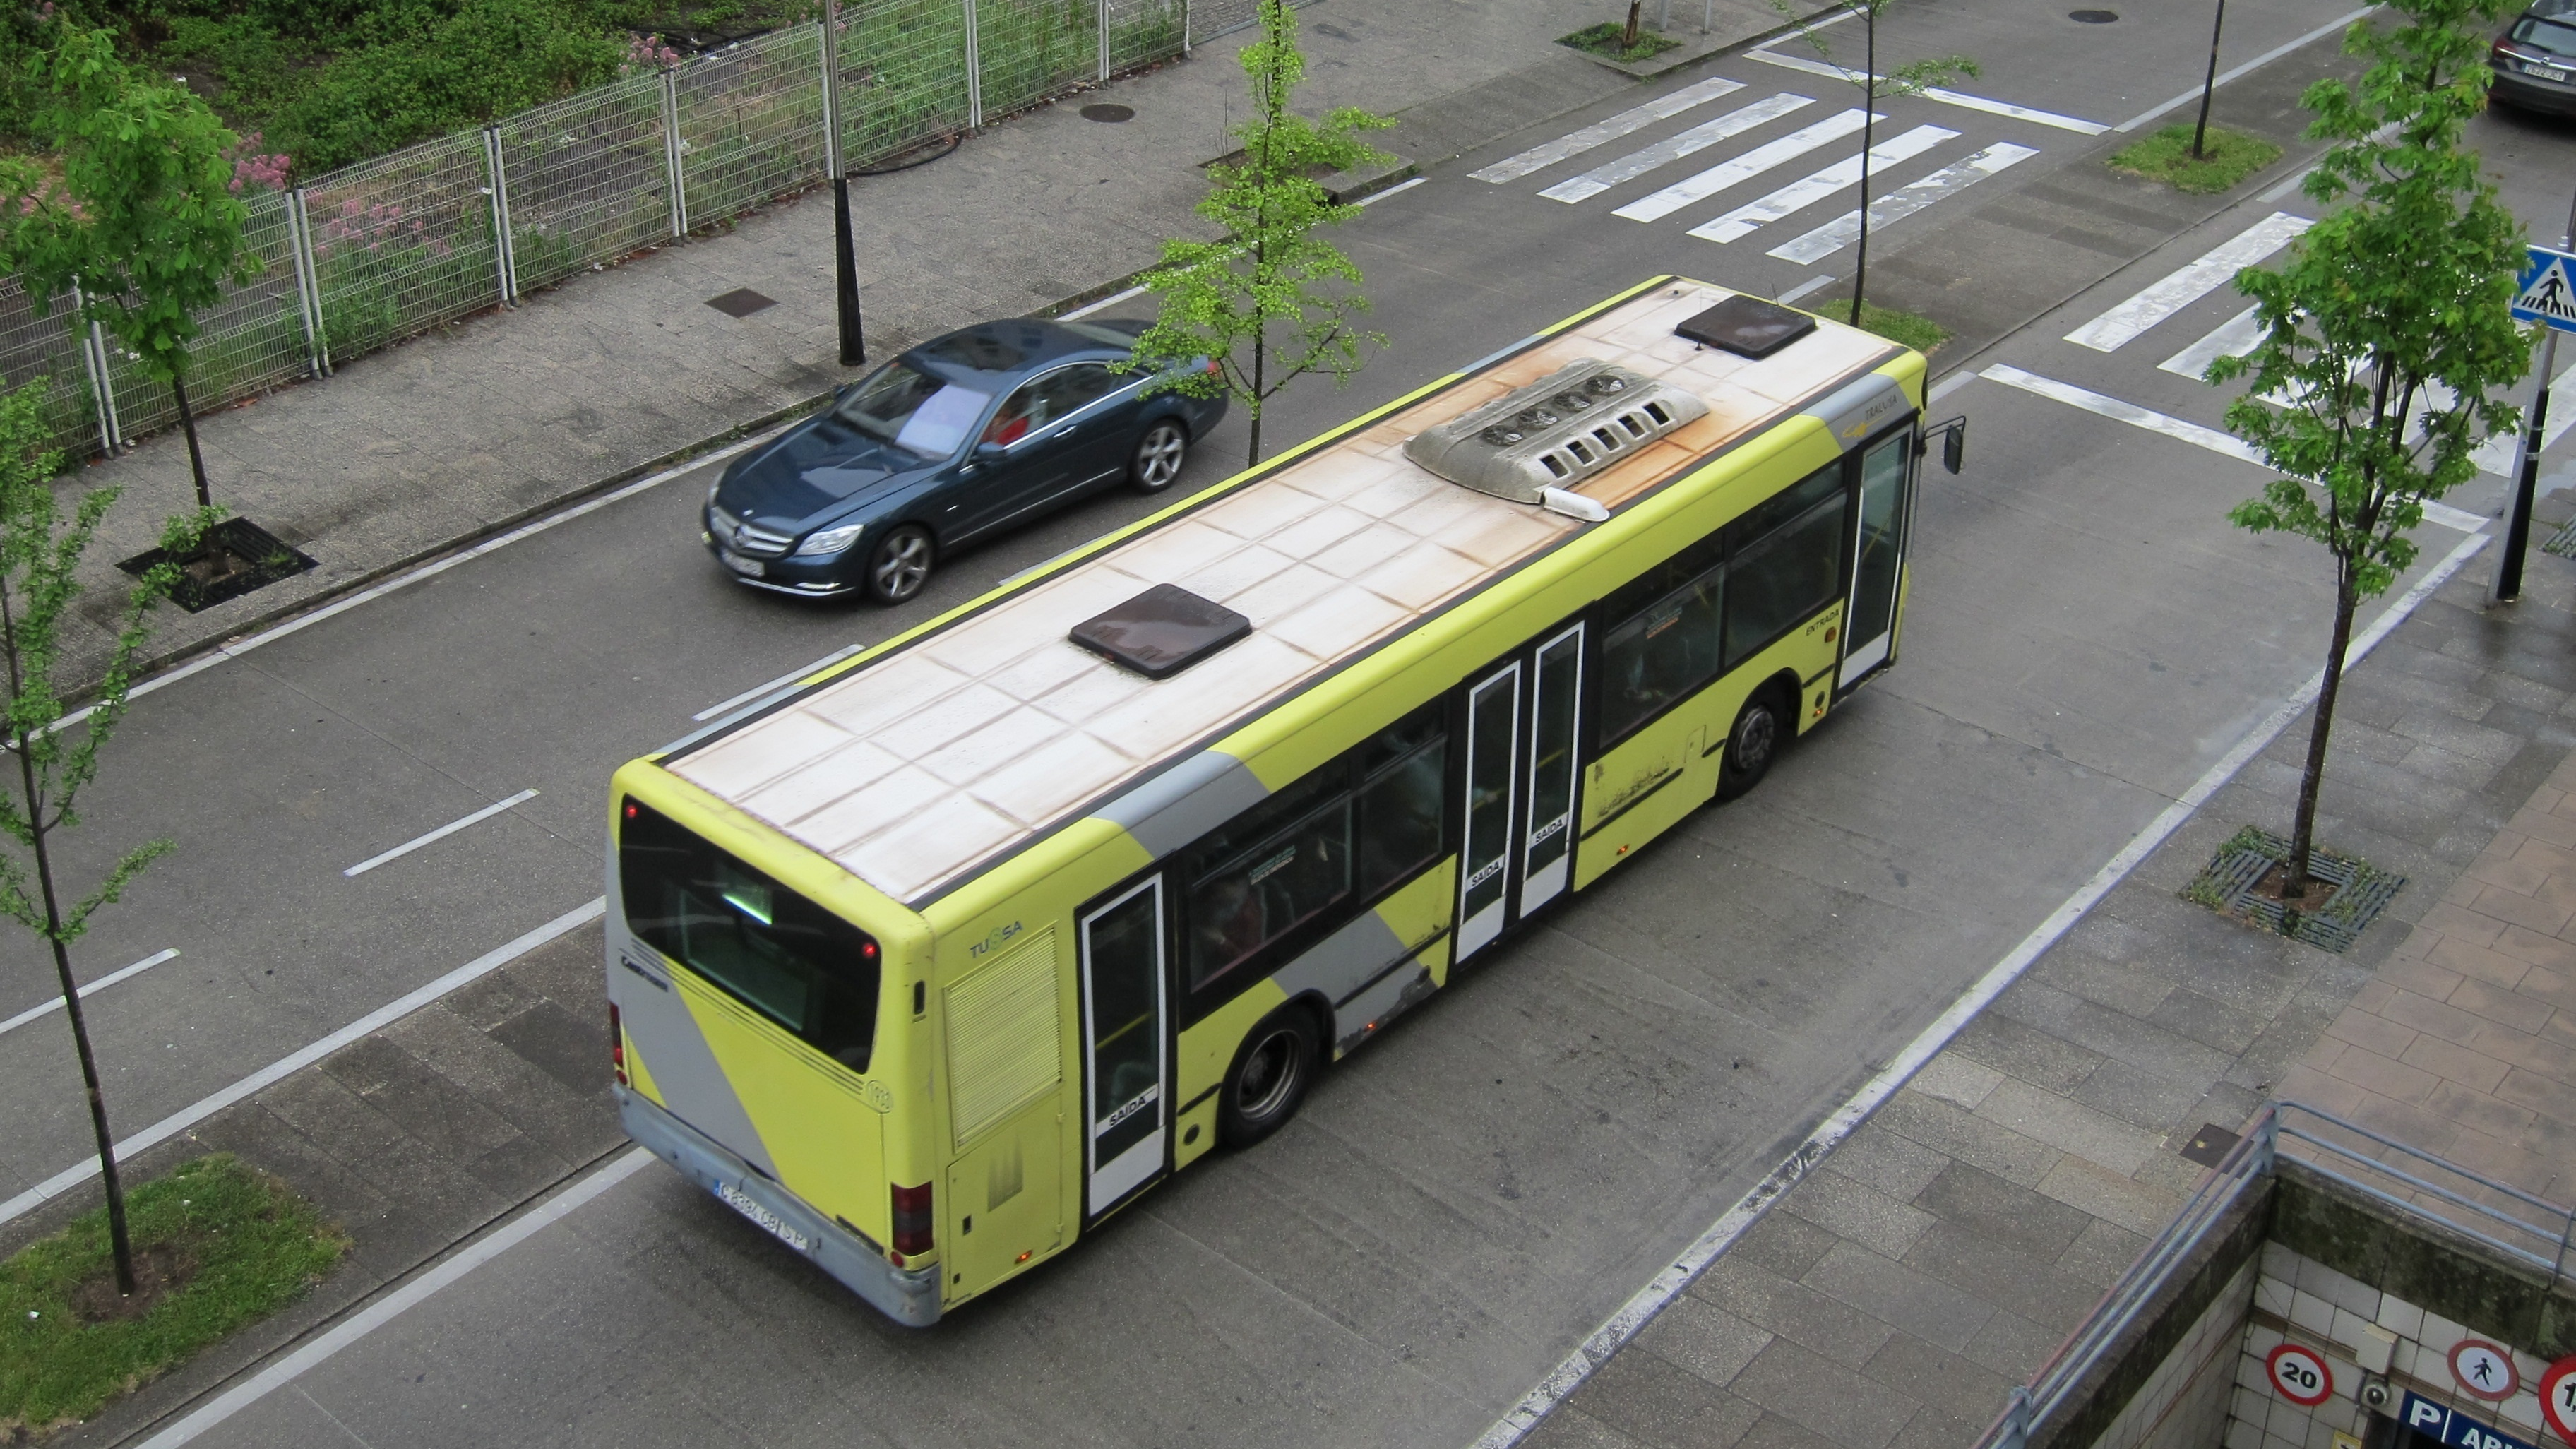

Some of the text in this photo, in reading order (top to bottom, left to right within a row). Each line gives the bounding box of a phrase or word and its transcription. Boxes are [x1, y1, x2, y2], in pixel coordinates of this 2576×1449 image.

[1806, 609, 1839, 636] ENTRADA
[2282, 1361, 2317, 1389] 20
[2409, 1398, 2441, 1427] P
